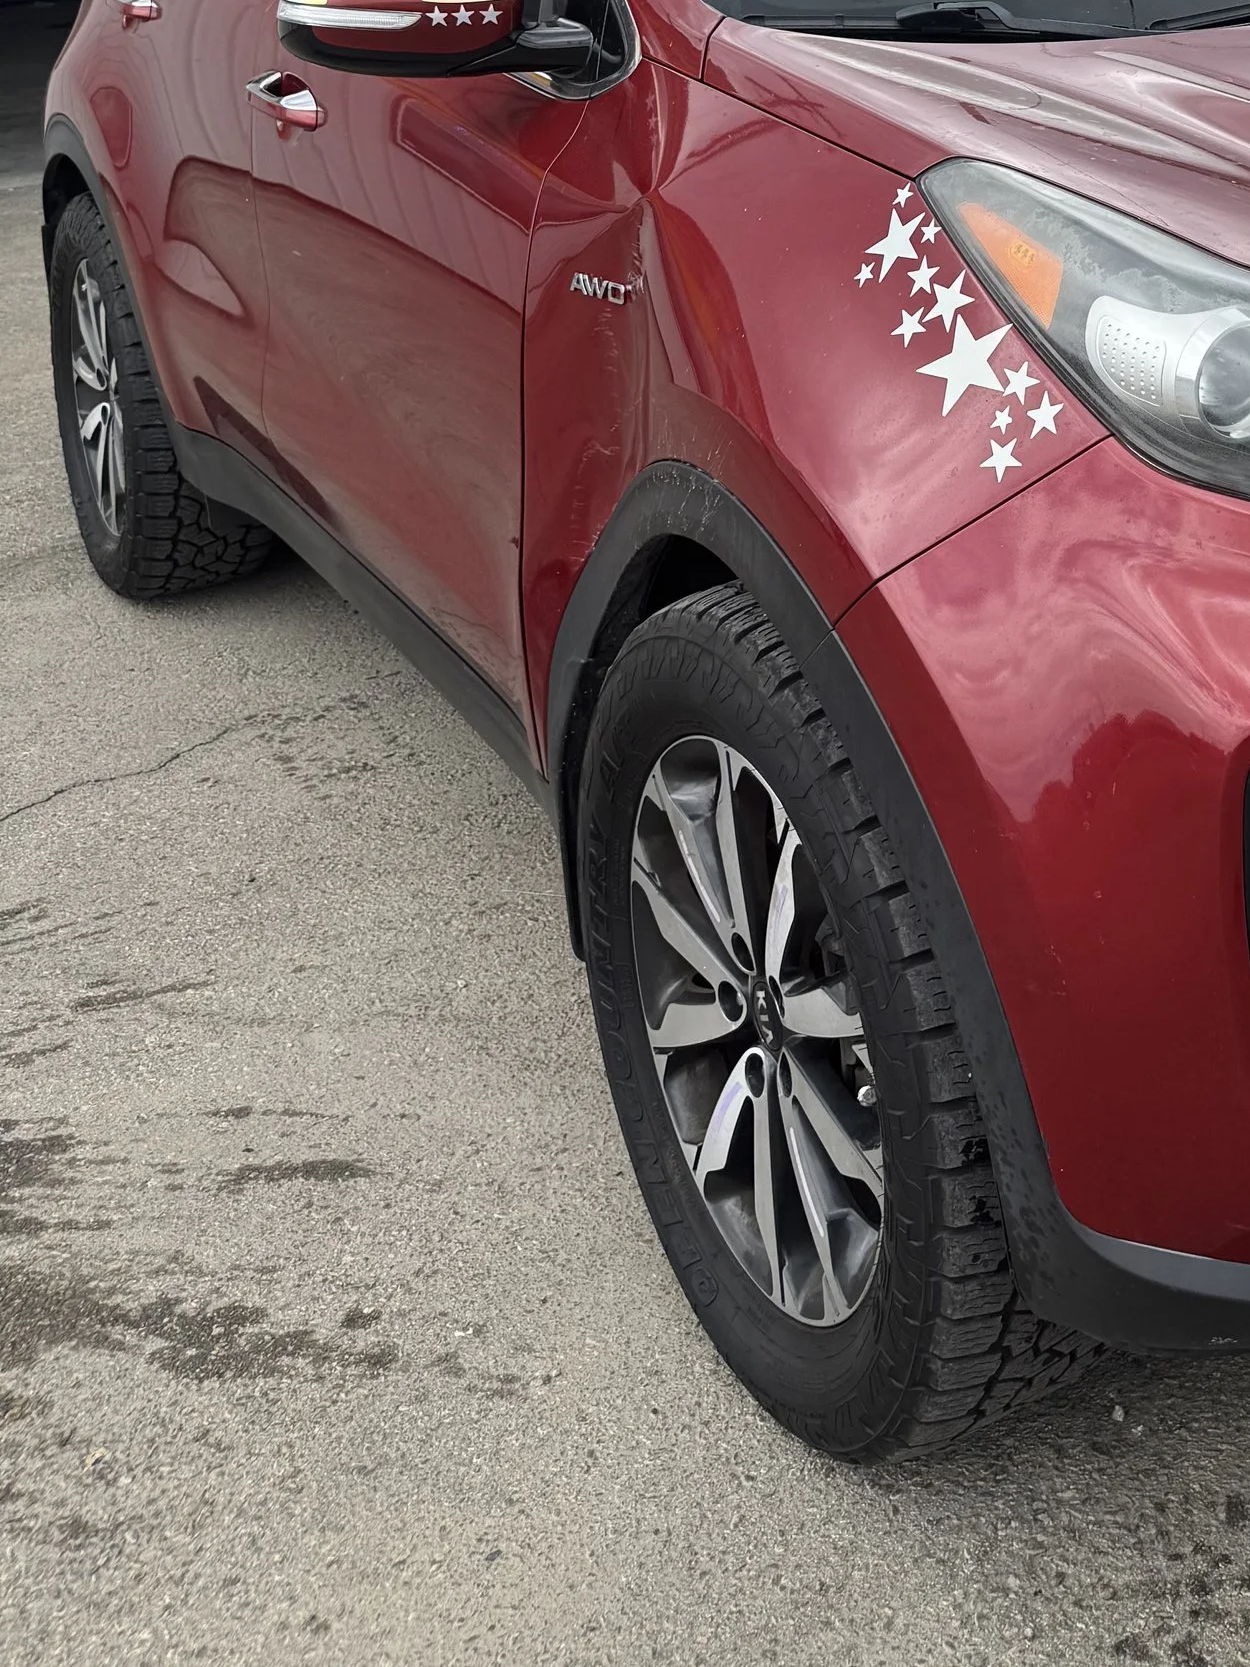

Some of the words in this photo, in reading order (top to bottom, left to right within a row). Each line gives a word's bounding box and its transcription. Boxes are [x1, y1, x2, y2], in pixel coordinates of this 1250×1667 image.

[569, 272, 625, 305] AWD
[587, 810, 646, 1123] COUNTRY
[756, 990, 774, 1045] KIA
[635, 1142, 718, 1306] OPEN
